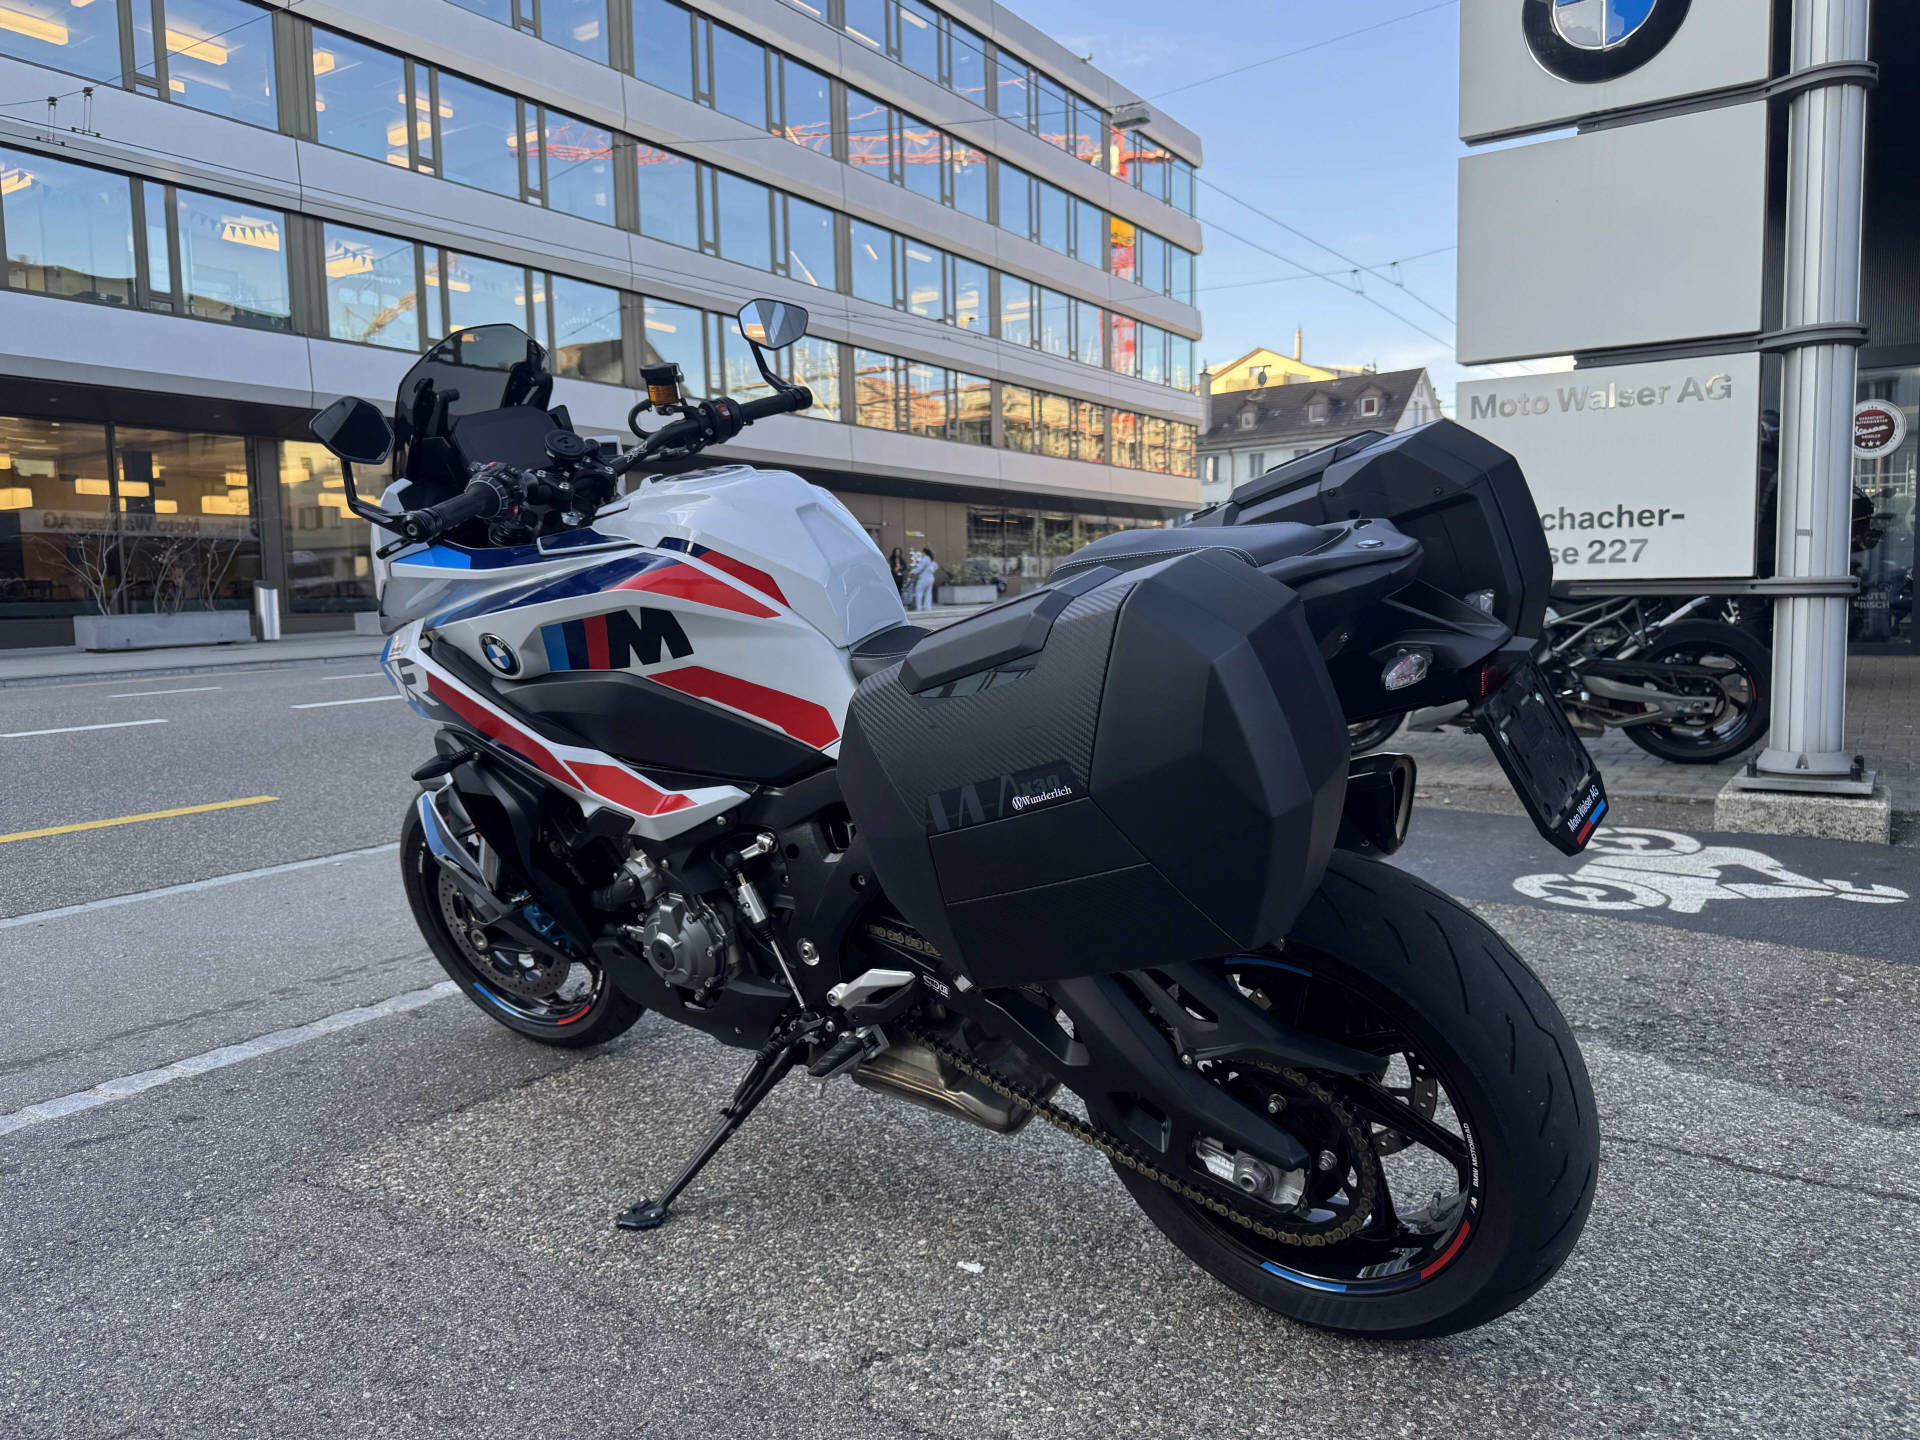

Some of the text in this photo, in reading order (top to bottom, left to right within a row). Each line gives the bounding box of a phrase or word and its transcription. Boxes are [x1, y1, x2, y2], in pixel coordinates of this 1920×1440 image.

[1470, 373, 1732, 420] Moto Walser AG
[1587, 538, 1649, 565] 227
[1022, 785, 1073, 805] Wunderlich
[1567, 784, 1599, 832] Moto Walser AG
